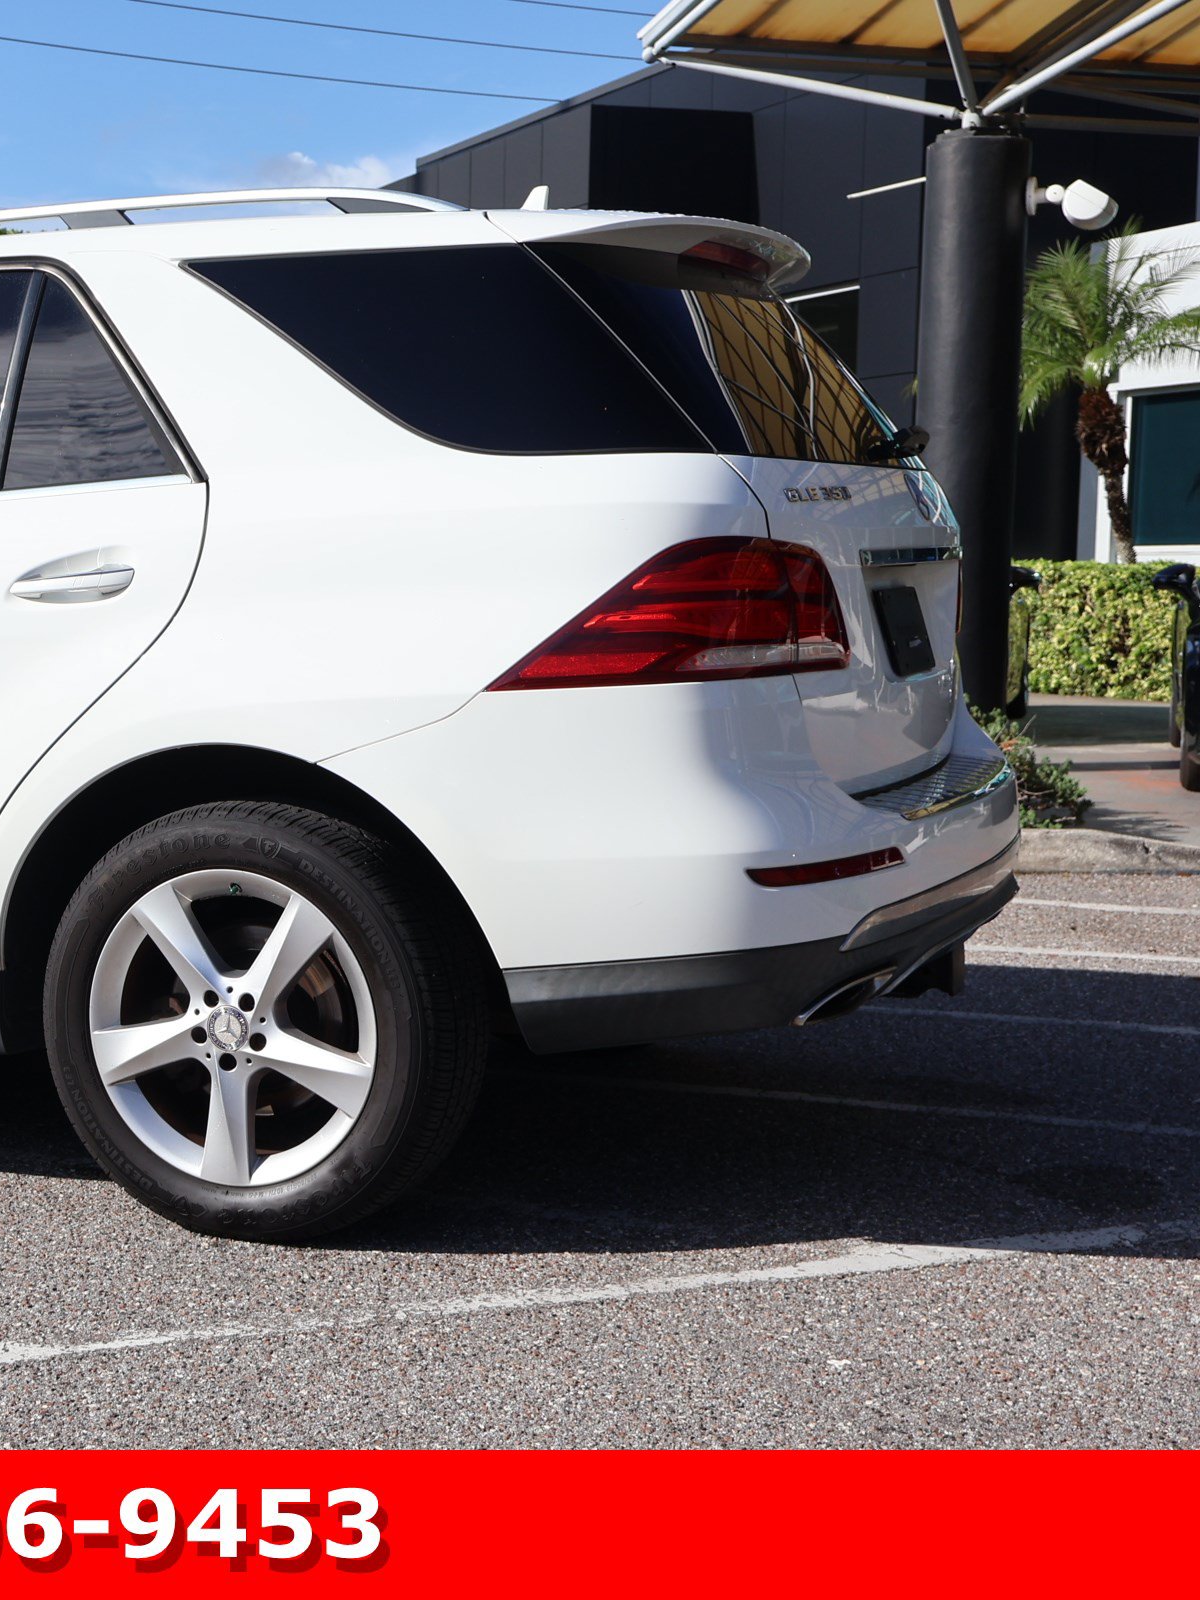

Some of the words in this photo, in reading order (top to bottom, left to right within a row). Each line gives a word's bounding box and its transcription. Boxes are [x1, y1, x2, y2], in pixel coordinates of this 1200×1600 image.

[783, 486, 820, 502] GLE
[299, 858, 390, 965] DESTINATION
[71, 1088, 155, 1191] DESTINATION
